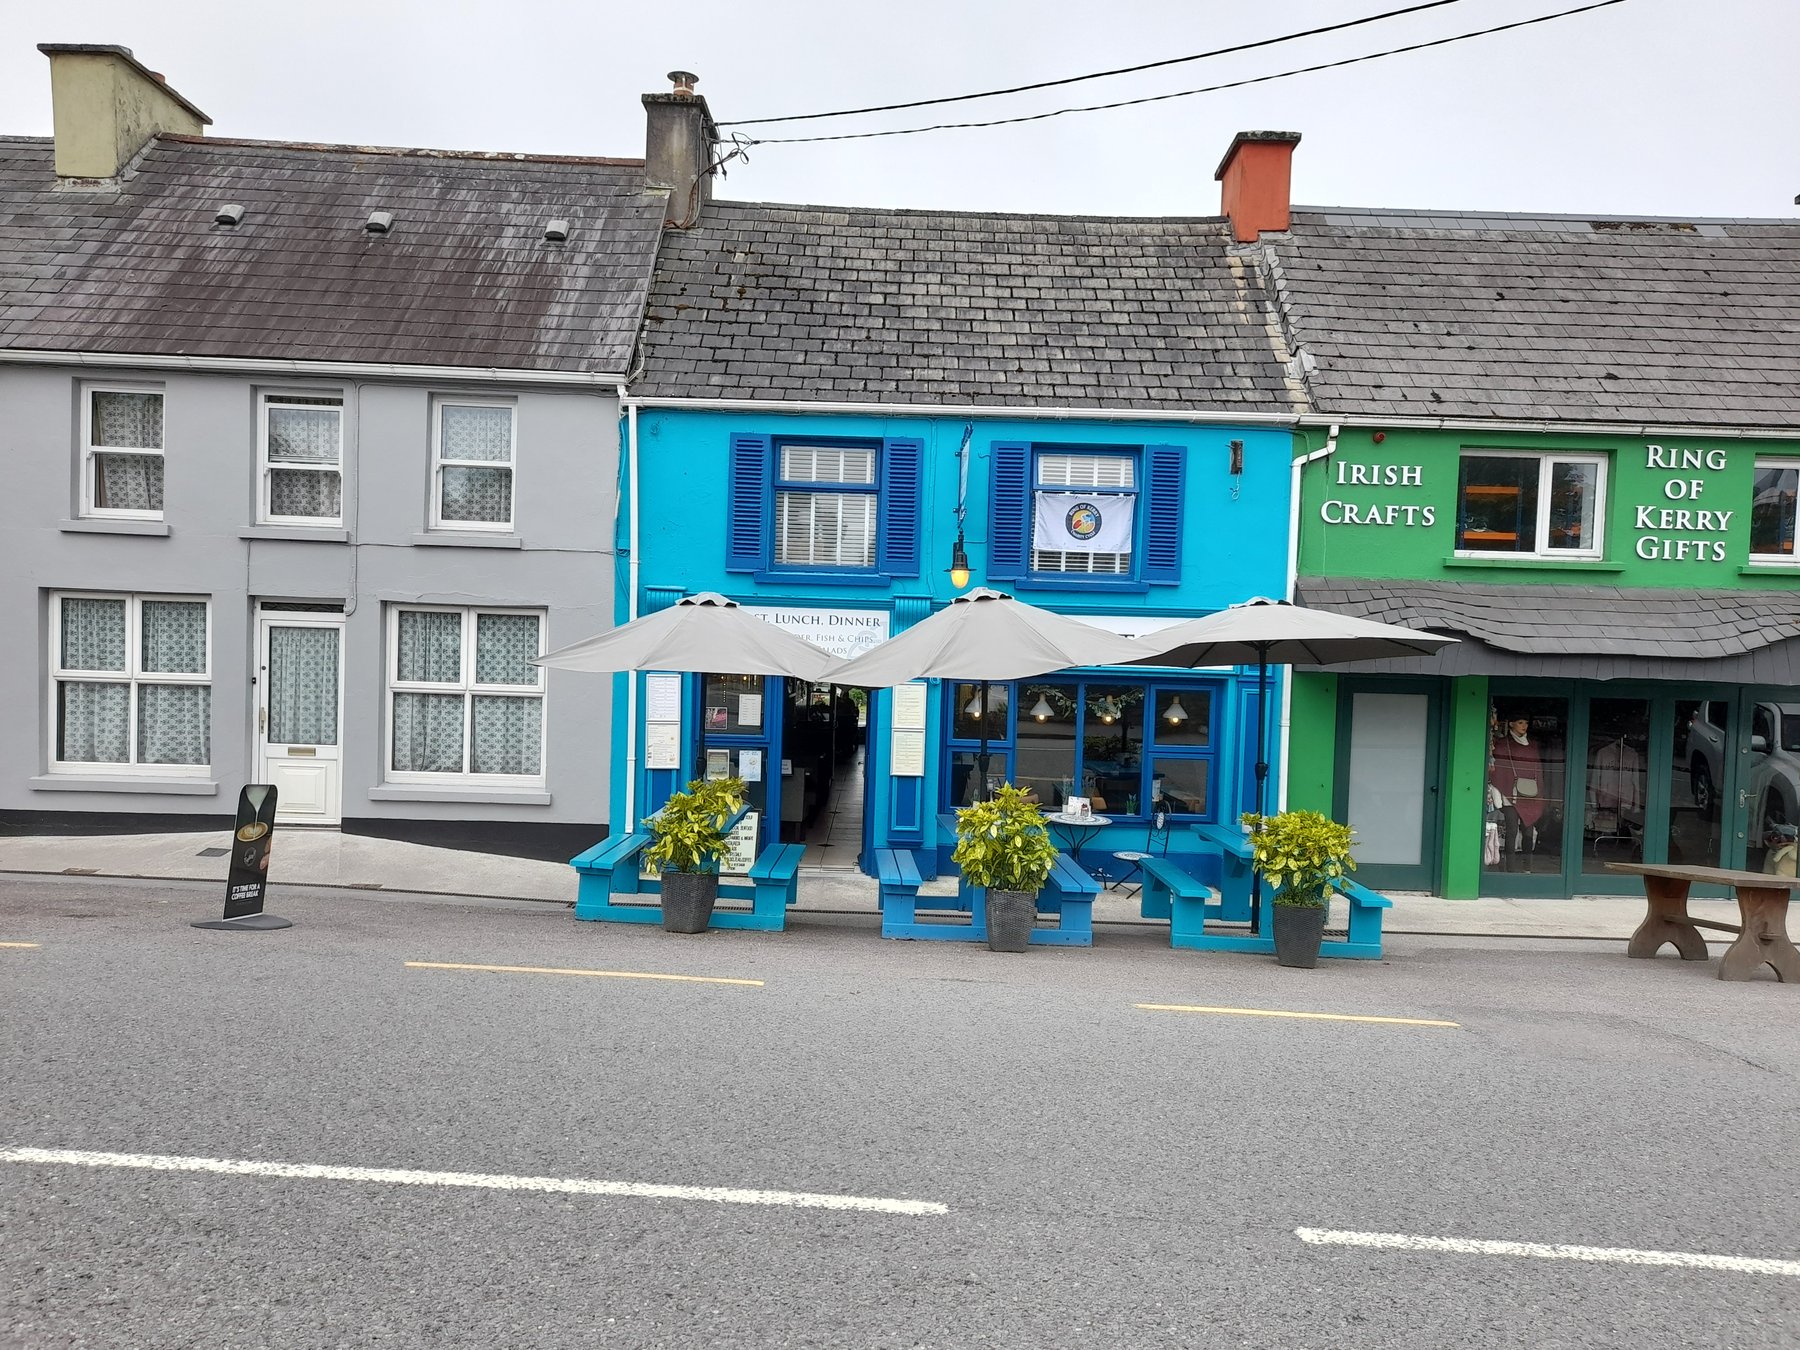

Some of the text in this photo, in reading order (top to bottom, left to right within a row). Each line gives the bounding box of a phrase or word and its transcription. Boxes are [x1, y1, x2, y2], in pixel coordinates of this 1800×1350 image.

[1646, 445, 1728, 470] RING
[1336, 461, 1423, 486] IRISH
[1664, 479, 1704, 499] OF
[1320, 500, 1436, 526] CRAFTS
[1635, 506, 1734, 531] KERRY
[1636, 536, 1726, 561] GIFTS
[829, 615, 881, 627] DINNER
[816, 634, 835, 642] FISH
[837, 634, 845, 643] &
[231, 892, 246, 901] COFFEE
